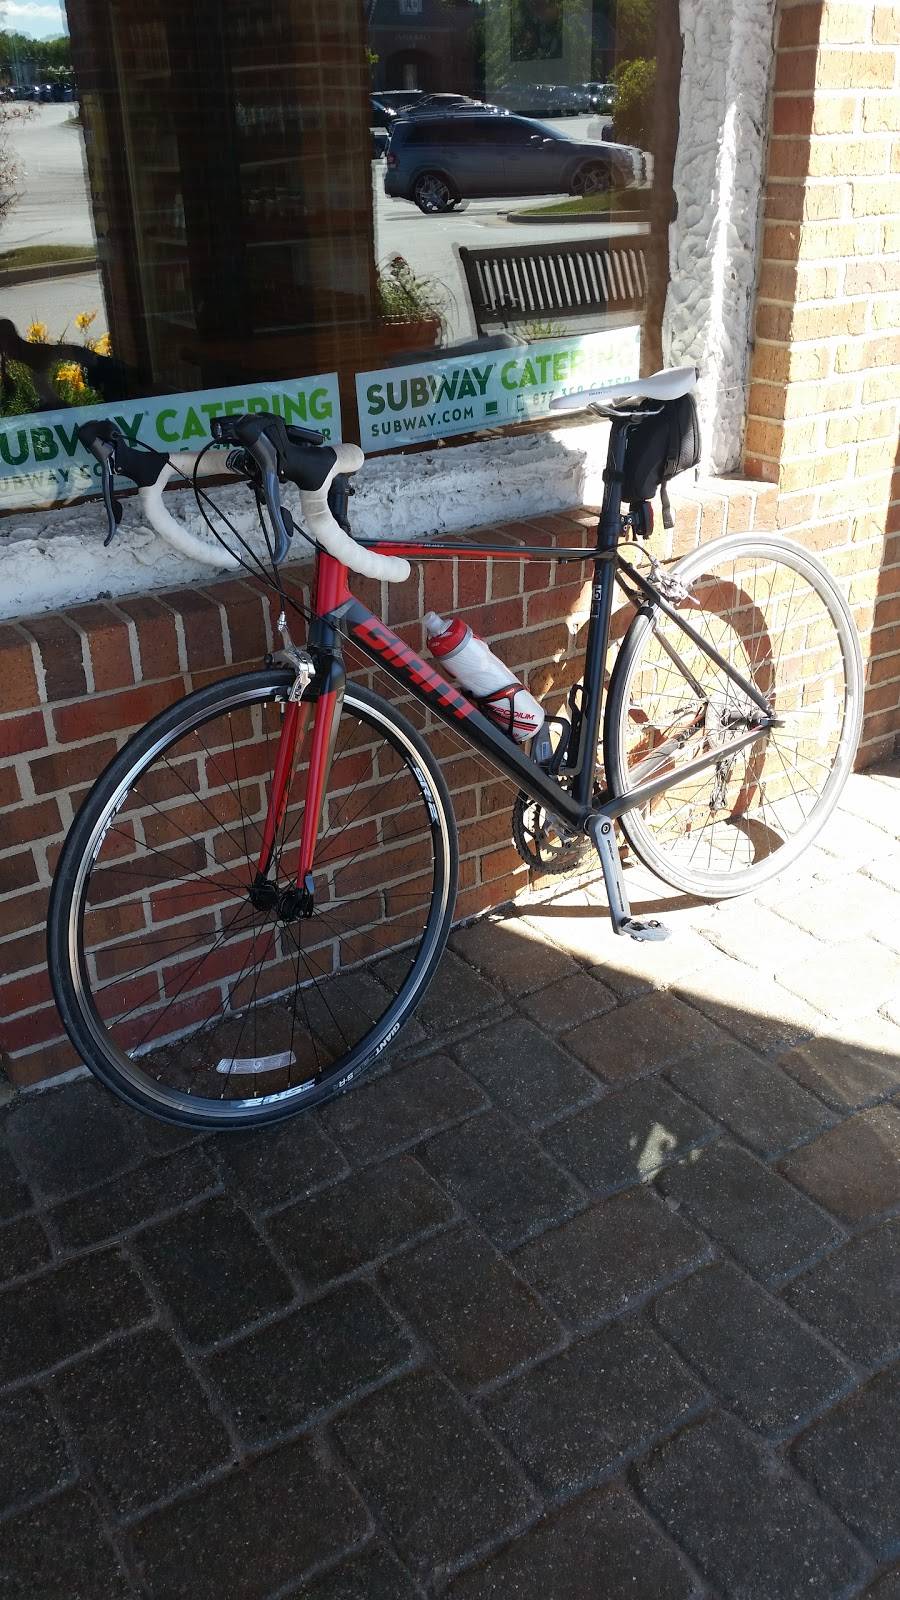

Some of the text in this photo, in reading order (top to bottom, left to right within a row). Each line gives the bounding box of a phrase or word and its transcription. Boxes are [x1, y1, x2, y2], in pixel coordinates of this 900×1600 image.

[366, 364, 494, 415] SUBWAY
[371, 407, 474, 437] SUBWAY.COM
[352, 616, 476, 720] GIANT
[373, 1022, 401, 1056] GIANT
